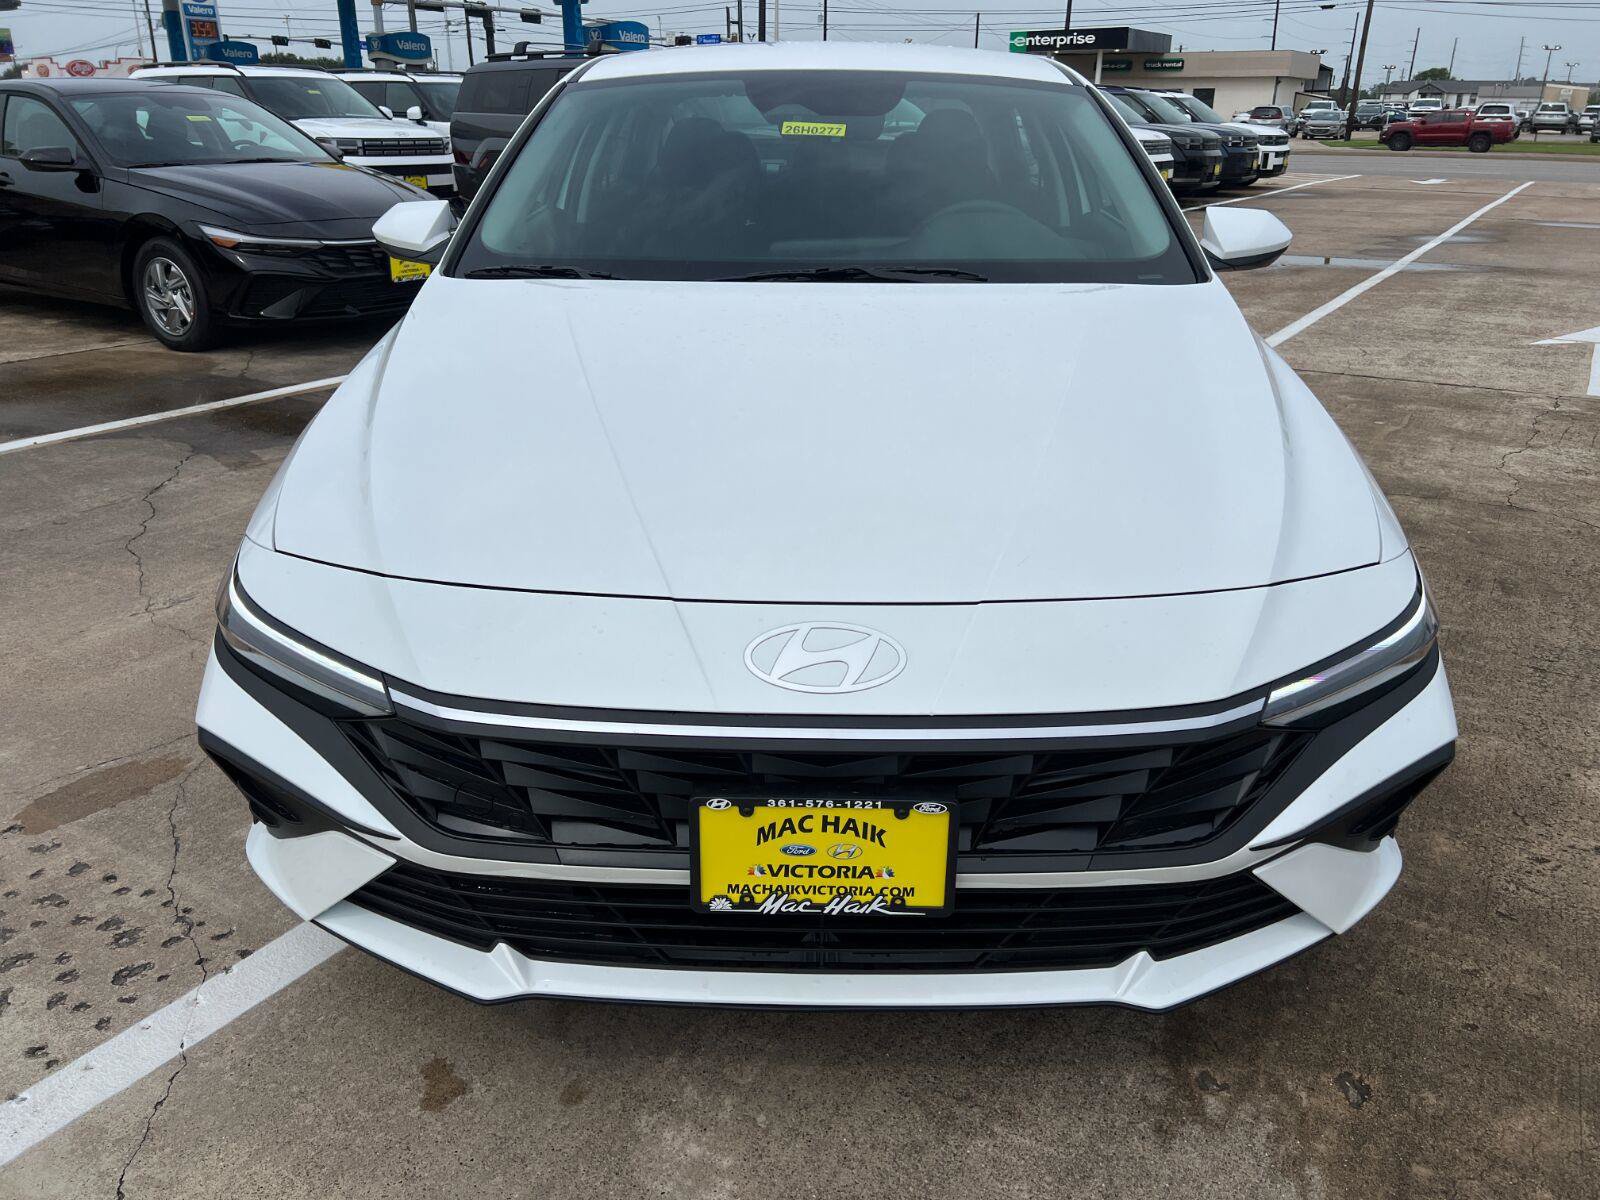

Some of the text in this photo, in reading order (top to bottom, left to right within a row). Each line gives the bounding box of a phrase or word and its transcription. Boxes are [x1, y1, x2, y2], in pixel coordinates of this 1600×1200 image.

[188, 5, 213, 15] Valero
[618, 30, 645, 43] Valero
[1010, 32, 1096, 48] enterprise
[397, 40, 426, 51] Valero
[222, 48, 253, 58] Valero
[785, 125, 842, 135] 26H0277
[767, 799, 882, 809] 361-576-1221
[756, 815, 887, 848] MAC HAIK
[767, 864, 875, 879] VICTORIA
[727, 883, 915, 898] MACHAIKVICTORIACOM
[760, 893, 896, 916] Mac Haik
